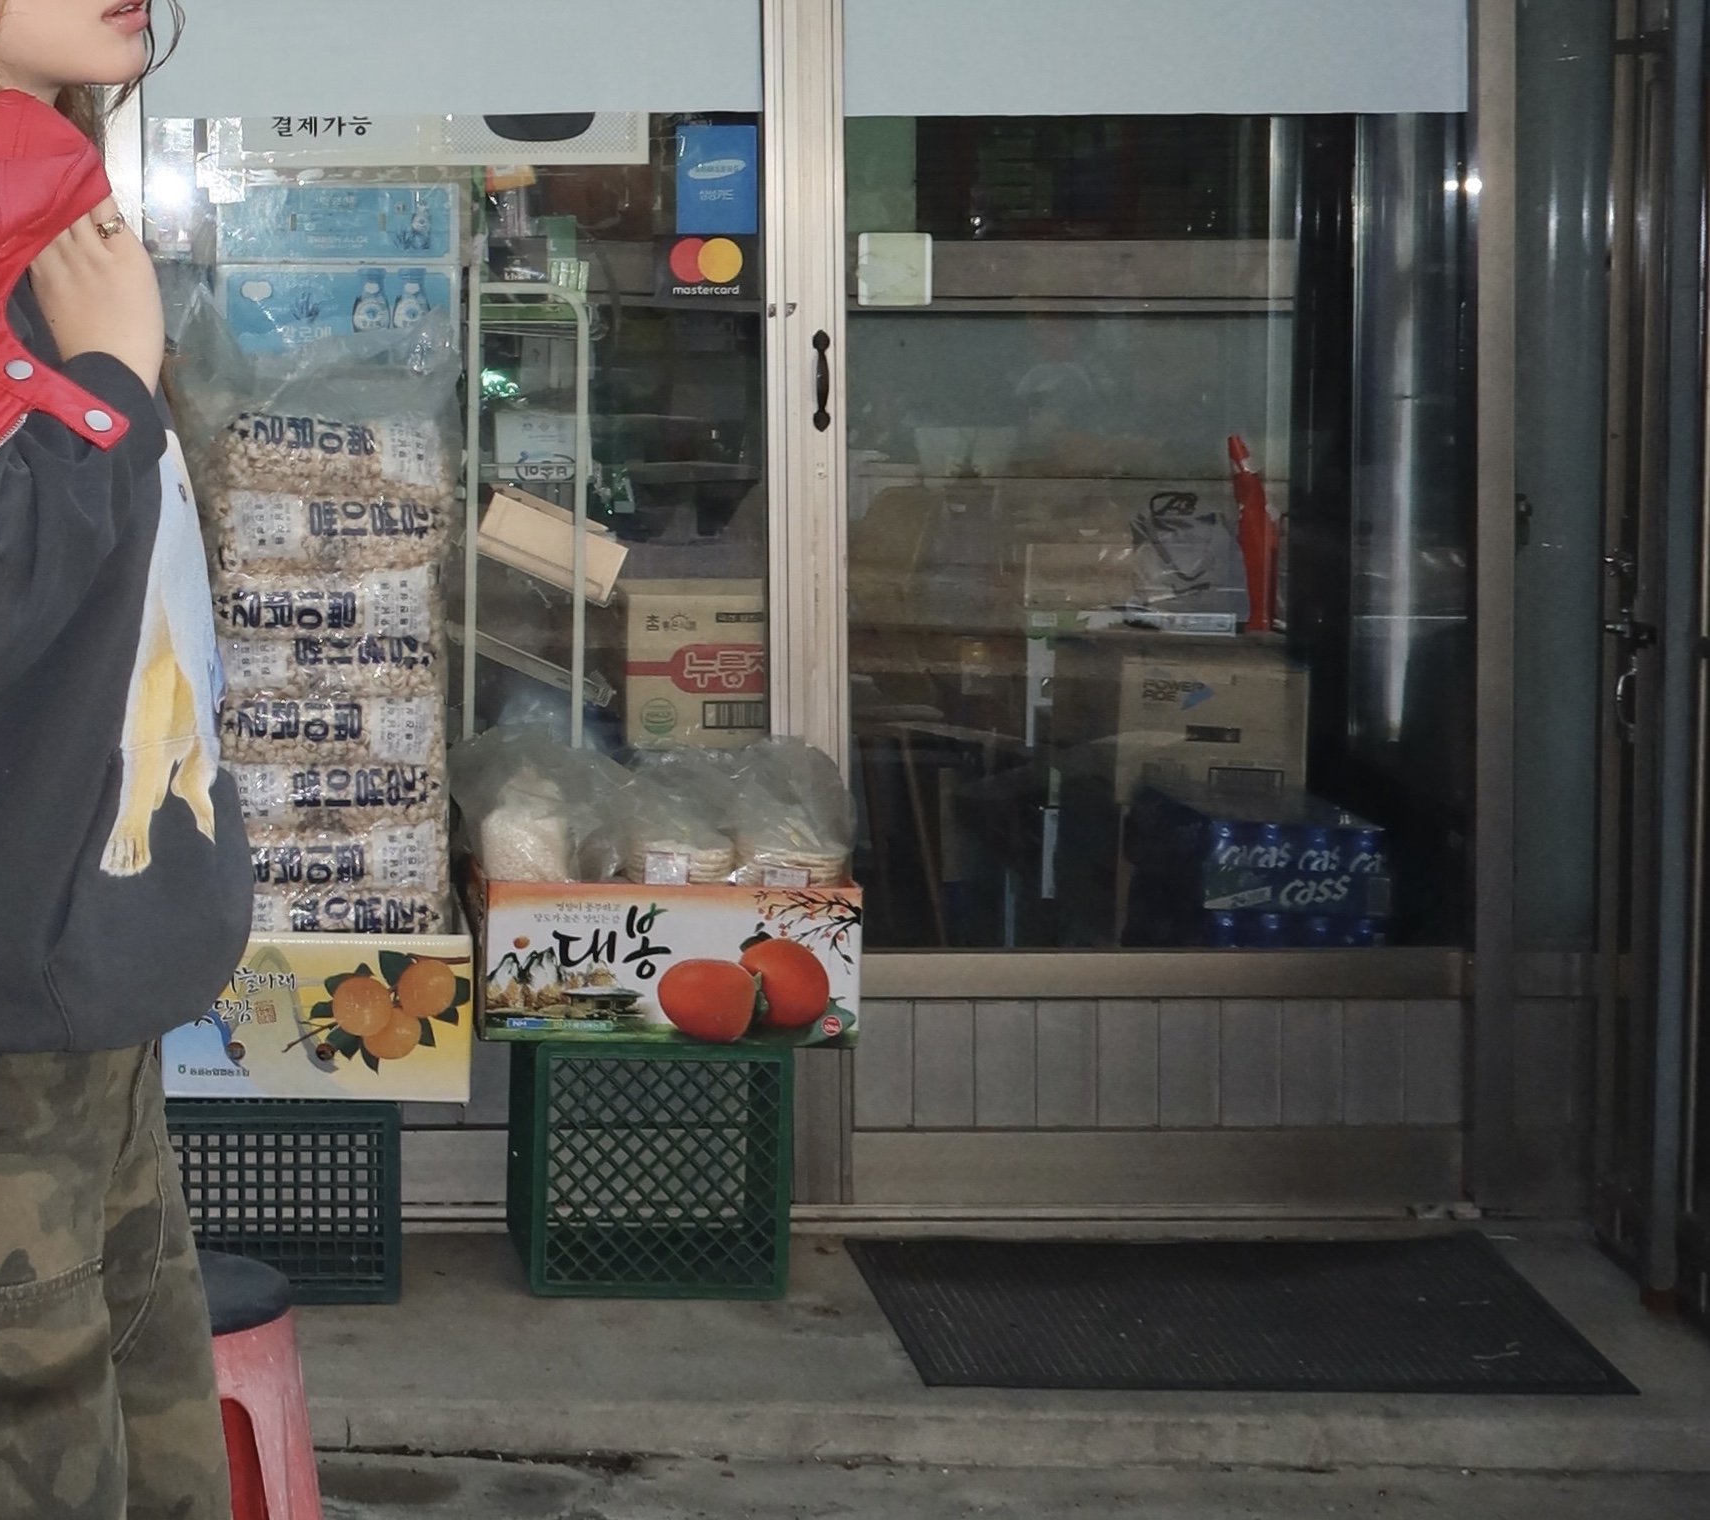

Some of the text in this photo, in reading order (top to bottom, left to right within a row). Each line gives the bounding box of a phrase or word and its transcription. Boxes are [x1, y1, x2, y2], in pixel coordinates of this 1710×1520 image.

[270, 115, 373, 138] 결제가능
[672, 284, 740, 296] mastercard
[551, 902, 673, 980] 대봉
